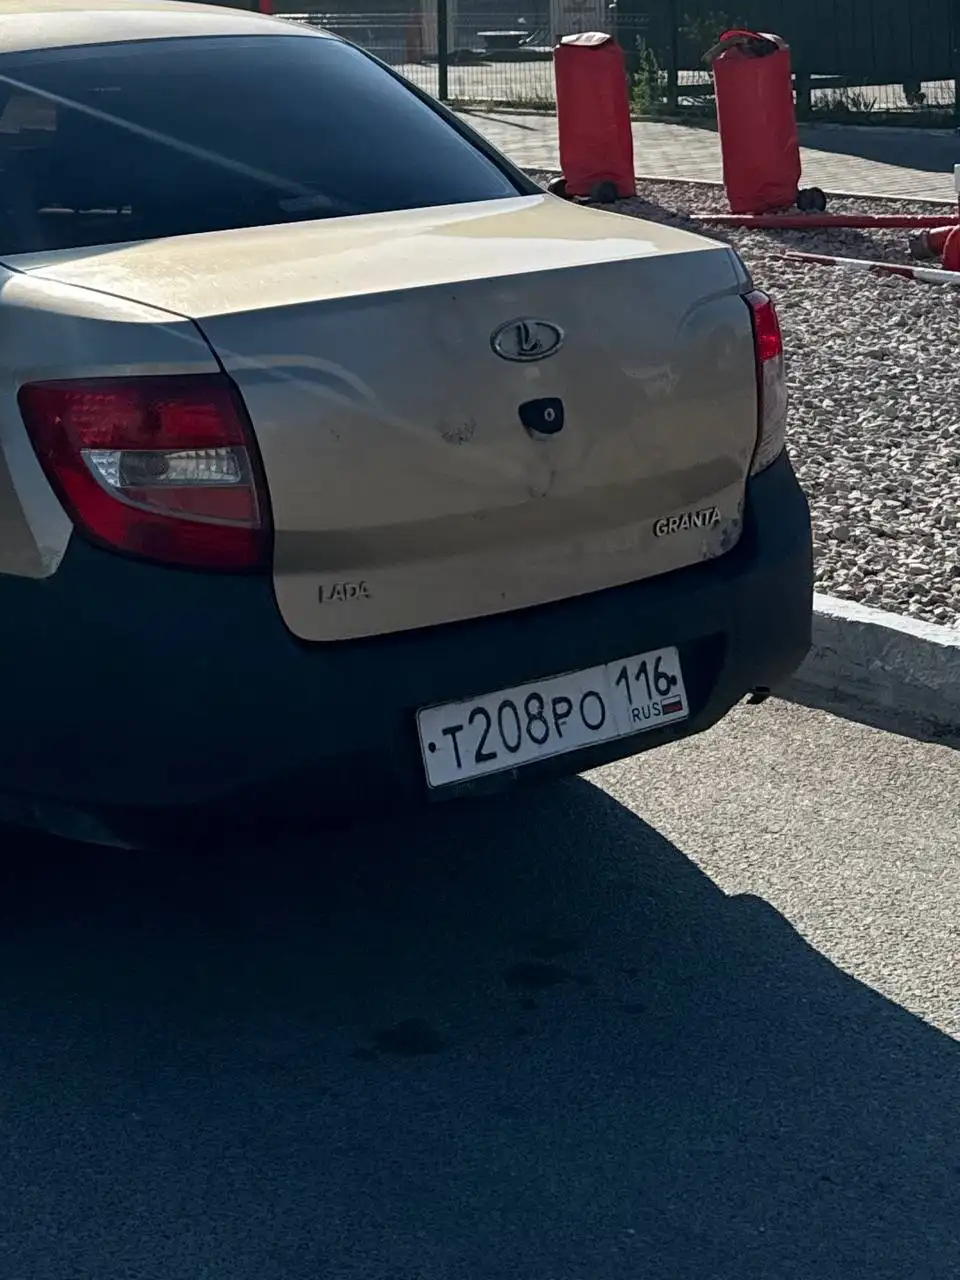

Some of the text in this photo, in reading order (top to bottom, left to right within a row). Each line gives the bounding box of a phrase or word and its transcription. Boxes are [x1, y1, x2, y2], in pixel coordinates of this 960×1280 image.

[653, 505, 721, 537] GRANTA
[318, 580, 371, 604] LADA
[615, 656, 673, 705] 116
[631, 702, 662, 723] RUS
